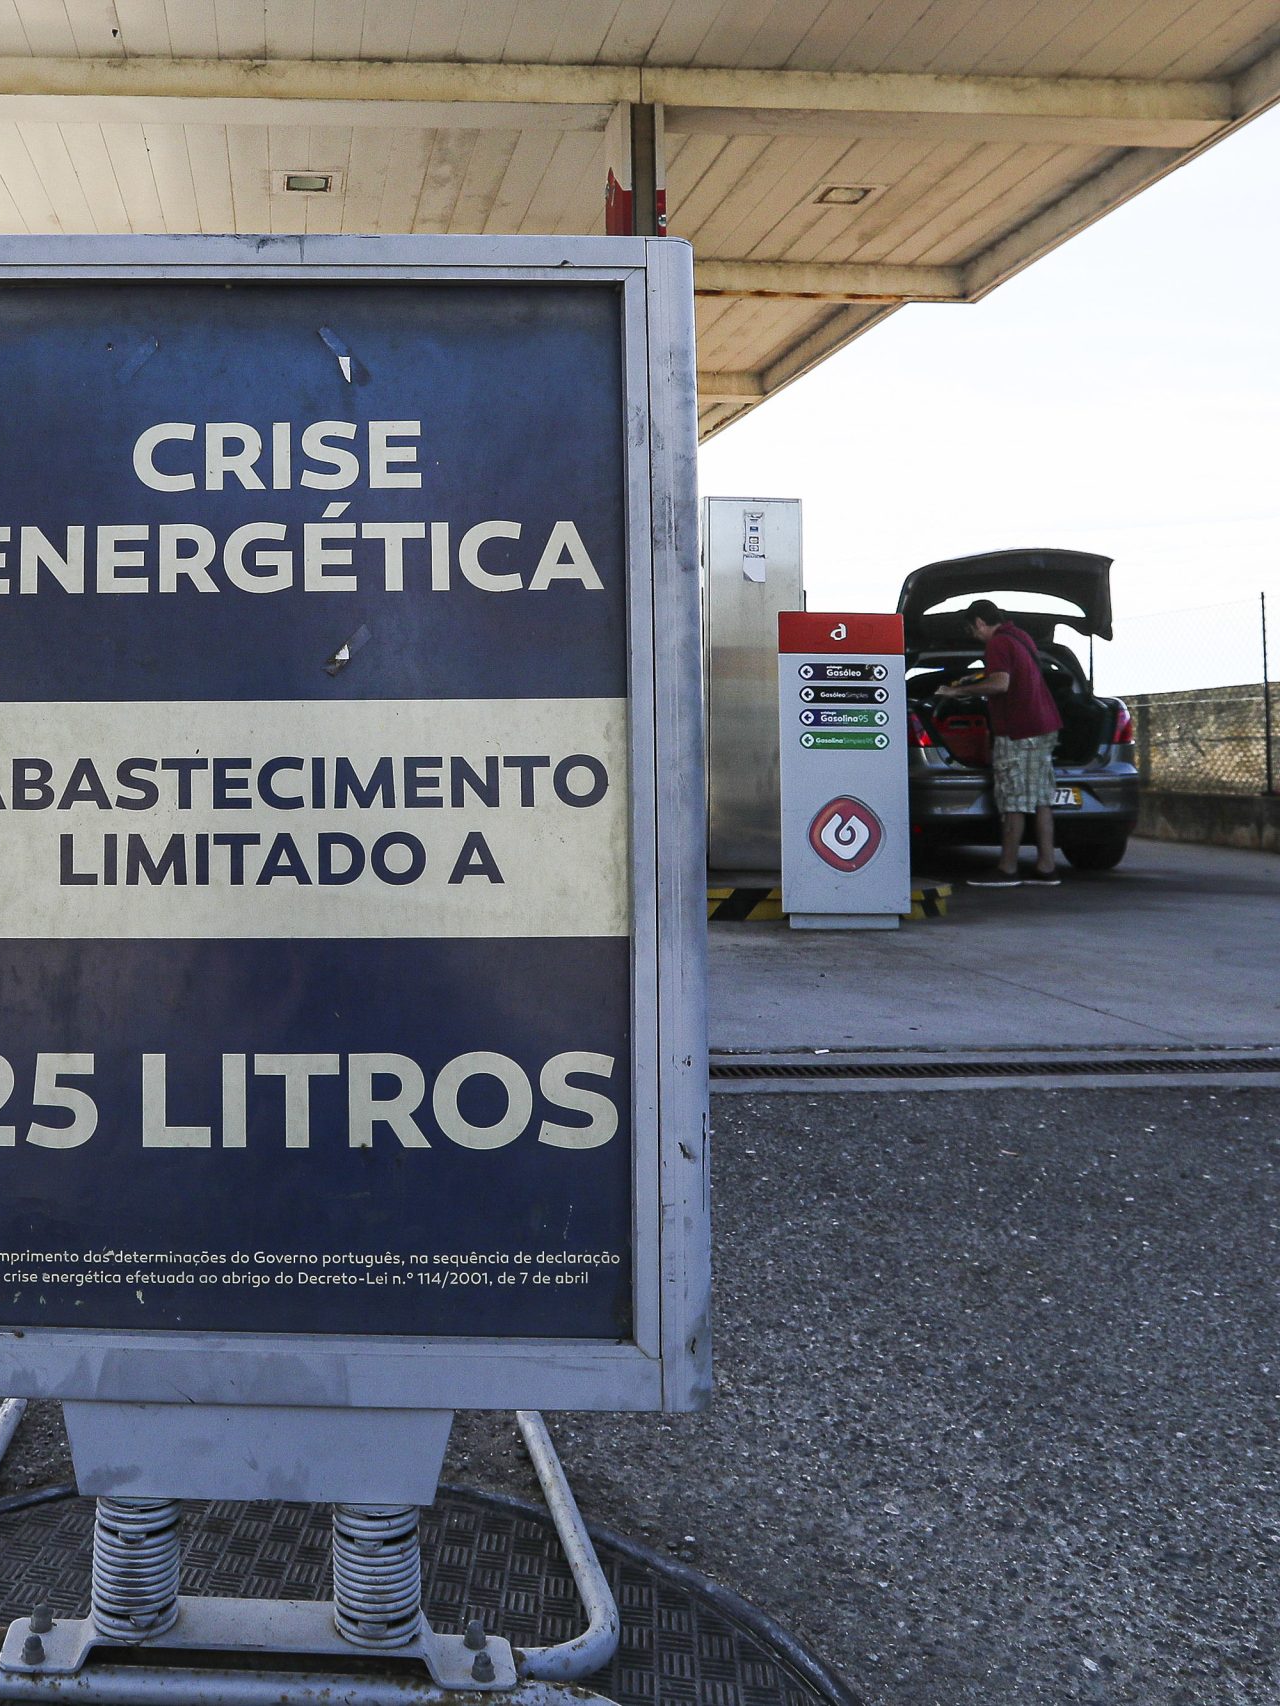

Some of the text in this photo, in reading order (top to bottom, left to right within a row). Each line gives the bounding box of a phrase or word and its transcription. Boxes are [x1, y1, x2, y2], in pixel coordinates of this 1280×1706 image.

[133, 421, 422, 492] CRISE
[826, 668, 862, 677] Gasóleo
[59, 831, 505, 886] LIMITADO A
[142, 1050, 619, 1149] LITROS
[83, 1249, 109, 1263] das
[114, 1250, 226, 1267] determinações
[231, 1251, 249, 1264] do
[254, 1251, 318, 1264] Governo
[322, 1251, 405, 1268] português,
[409, 1255, 428, 1265] na
[433, 1251, 508, 1268] sequência
[513, 1251, 532, 1265] de
[536, 1251, 620, 1268] declaração
[3, 1270, 38, 1283] crise
[42, 1270, 121, 1287] energética
[126, 1269, 195, 1284] efetuada
[199, 1274, 218, 1284] ao
[222, 1270, 271, 1288] abrigo
[275, 1271, 294, 1285] do
[298, 1271, 388, 1285] Decreto-Lei
[417, 1271, 493, 1289] 114/2001,
[497, 1271, 516, 1285] de
[520, 1272, 529, 1285] 7
[532, 1271, 551, 1285] de
[555, 1271, 589, 1285] abril
